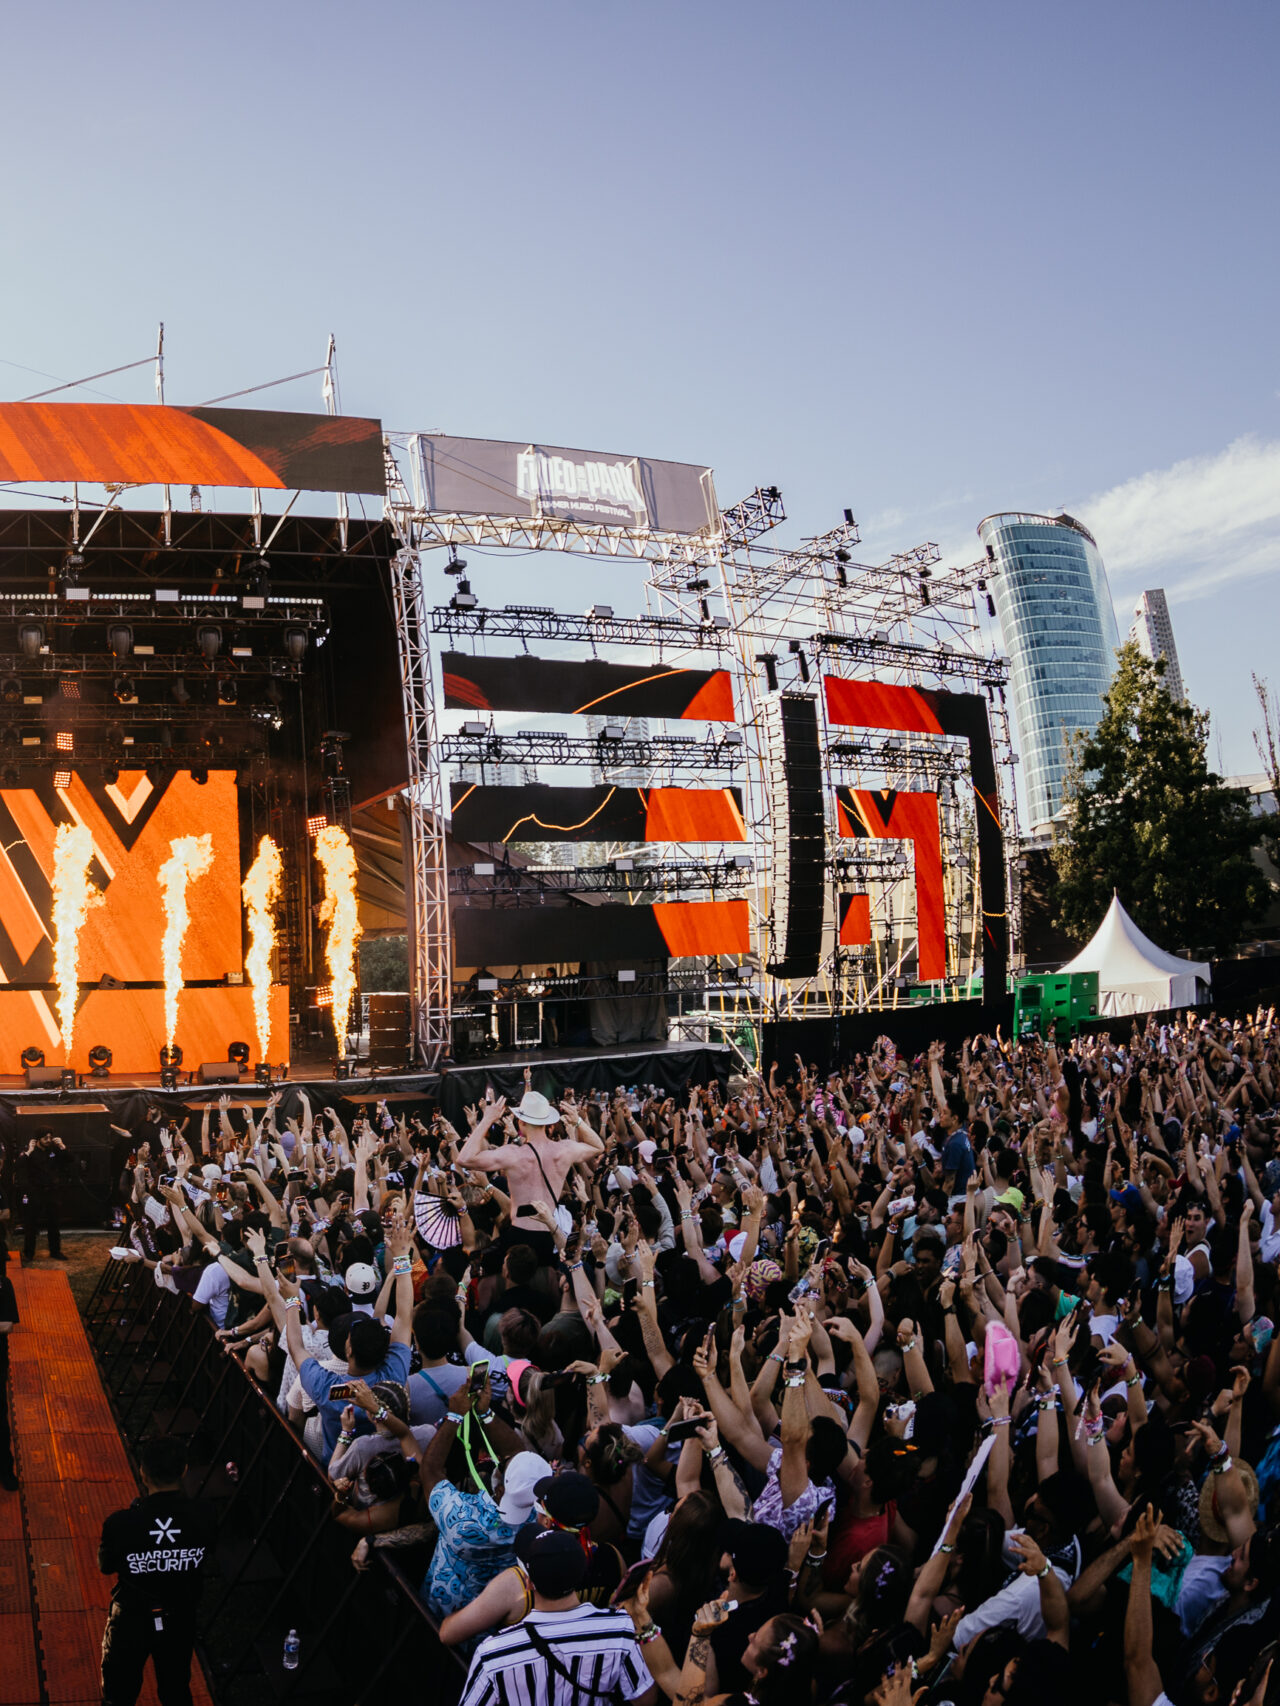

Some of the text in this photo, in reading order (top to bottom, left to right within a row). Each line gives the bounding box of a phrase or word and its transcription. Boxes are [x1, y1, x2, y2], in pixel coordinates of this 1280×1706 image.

[586, 462, 646, 511] PARK
[570, 502, 594, 512] MUSIC
[595, 504, 632, 519] FESTIVAL
[126, 1547, 206, 1562] GUARDTECK
[128, 1556, 204, 1574] SECURITY
